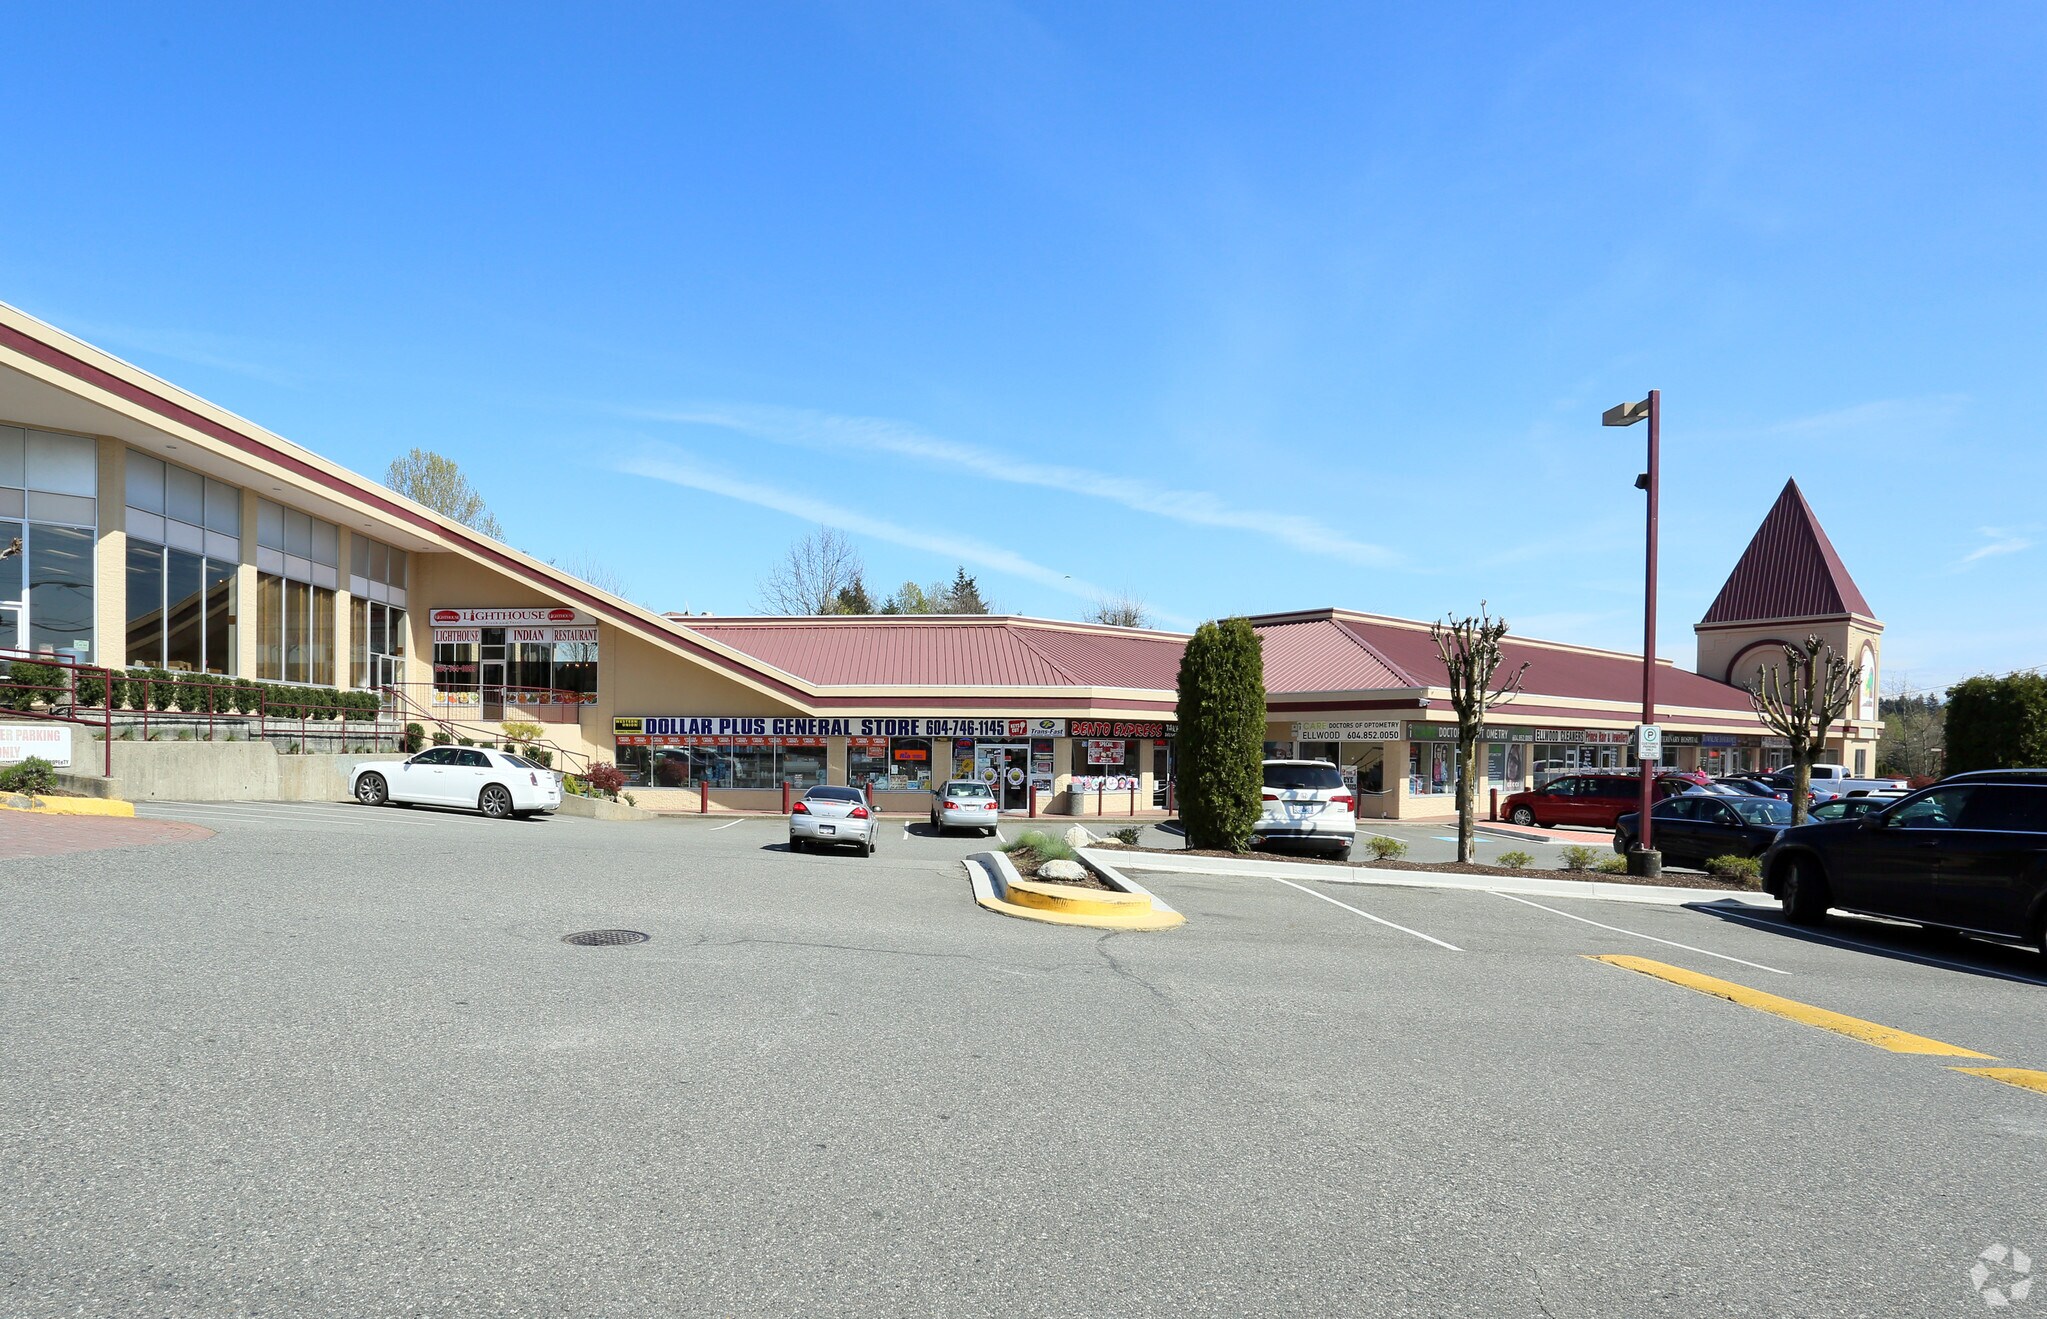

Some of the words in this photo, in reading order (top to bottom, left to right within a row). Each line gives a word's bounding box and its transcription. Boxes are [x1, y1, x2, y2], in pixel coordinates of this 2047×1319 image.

[463, 609, 545, 621] LIGHTHOUSE
[435, 630, 480, 642] LIGHTHOUSE
[513, 629, 545, 641] INDIAN
[554, 629, 598, 641] RESTAURANT
[645, 718, 713, 735] DOLLAR
[720, 718, 766, 735] PLUS
[772, 718, 852, 736] GENERAL
[861, 719, 920, 736] STORE
[926, 719, 1005, 736] 604-746-1145
[1071, 721, 1111, 737] BENTO
[1113, 722, 1163, 738] EXPRESS
[1303, 722, 1327, 730] CARE
[1364, 721, 1400, 729] OPTOMETRY
[15, 729, 60, 742] PARKING
[1302, 731, 1341, 740] ELLWOOD
[1346, 731, 1400, 740] 604.852.0050
[1438, 726, 1460, 738] DOCTO
[1536, 730, 1559, 741] ELLWOOD
[1560, 730, 1585, 742] CLEANERS
[1647, 730, 1654, 739] P
